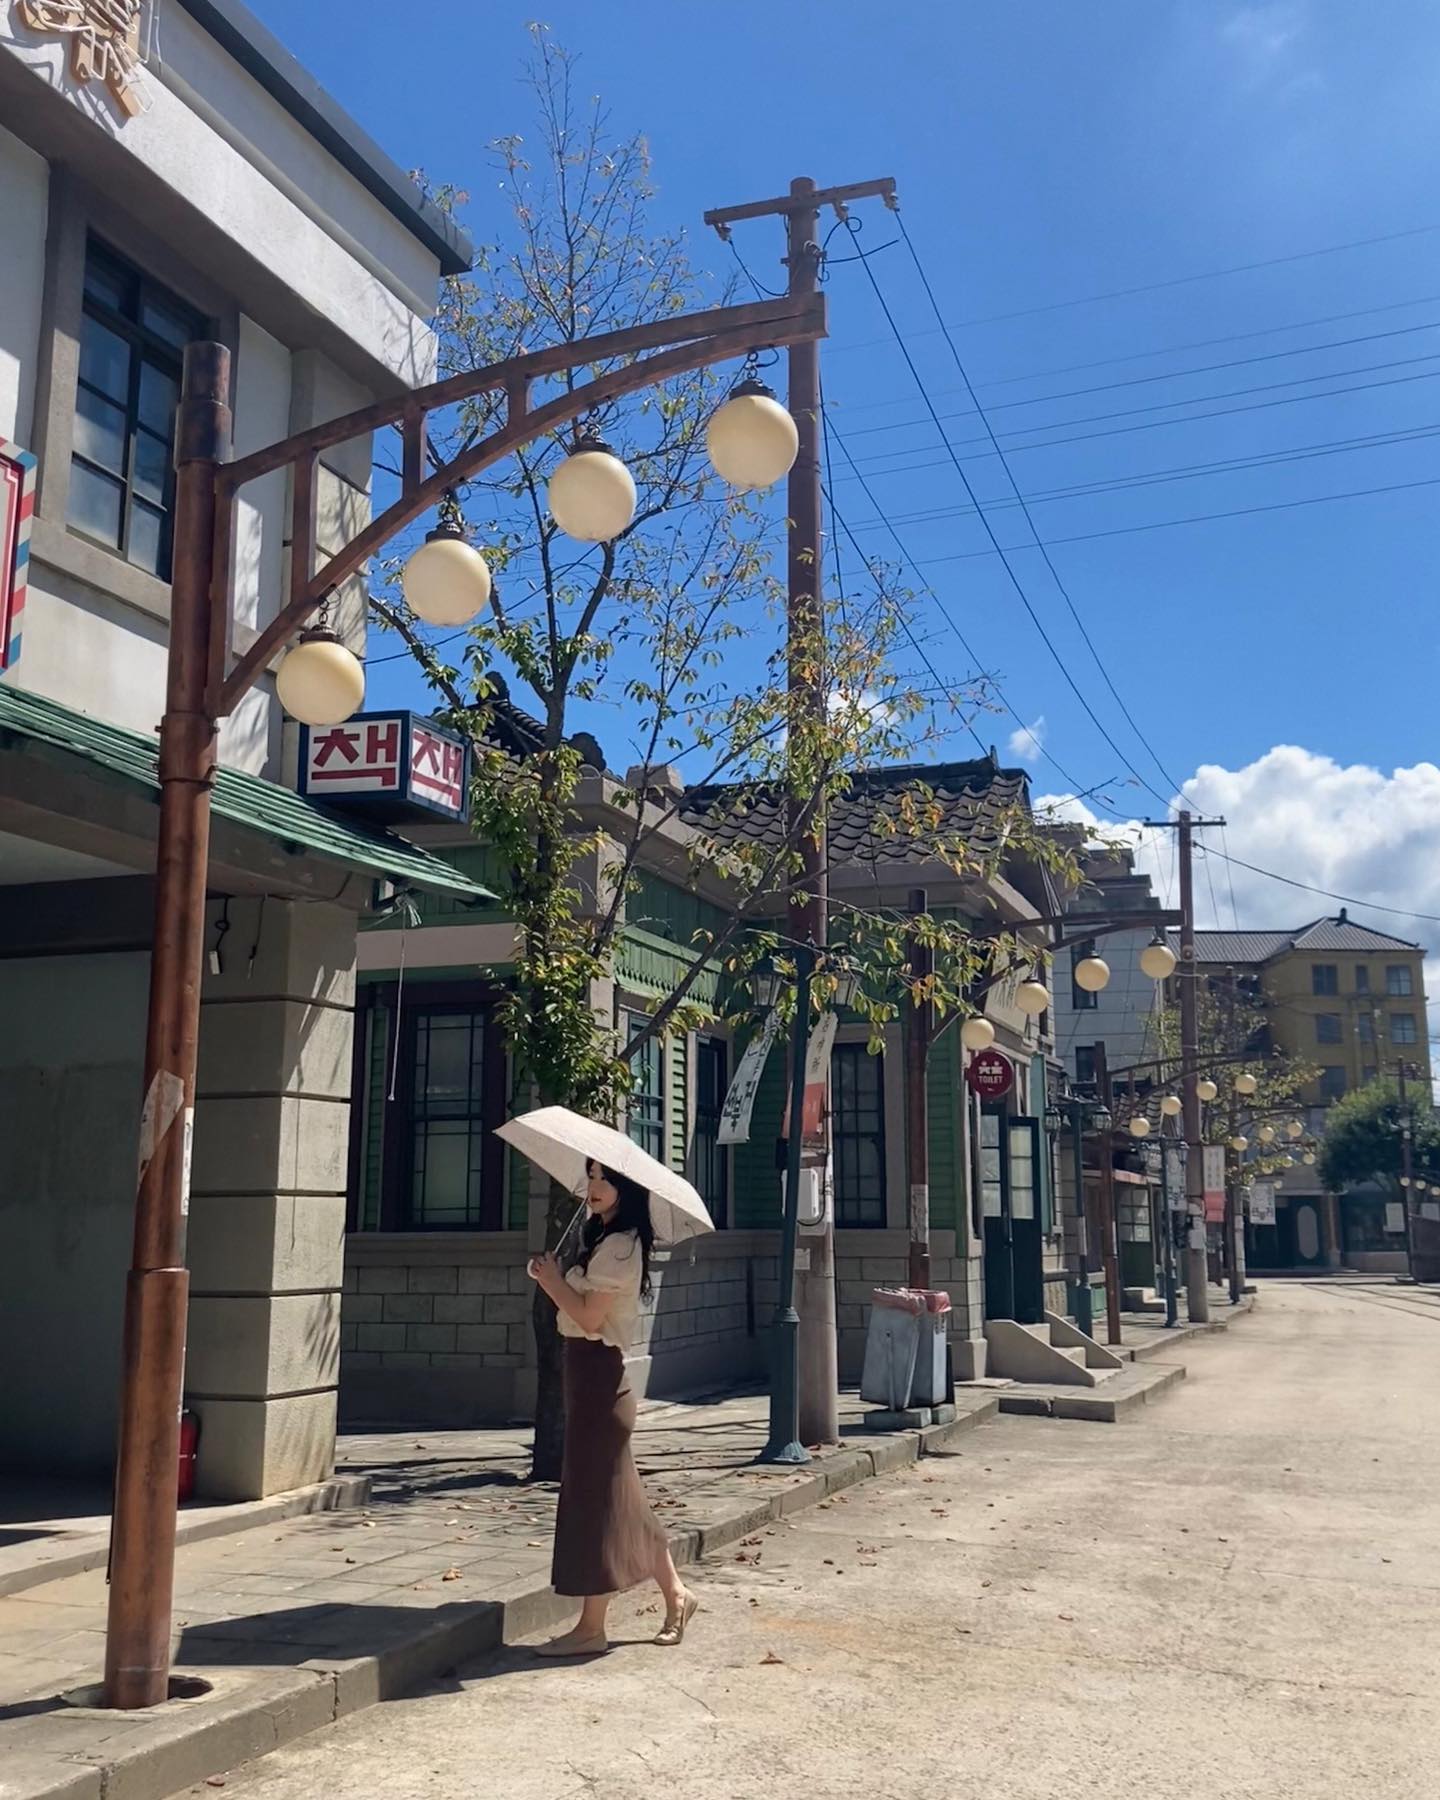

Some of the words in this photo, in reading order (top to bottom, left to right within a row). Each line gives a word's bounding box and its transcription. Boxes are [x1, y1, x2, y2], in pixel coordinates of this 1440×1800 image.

[311, 723, 399, 787] 책
[412, 731, 462, 807] 책
[977, 1075, 1003, 1084] TOILET
